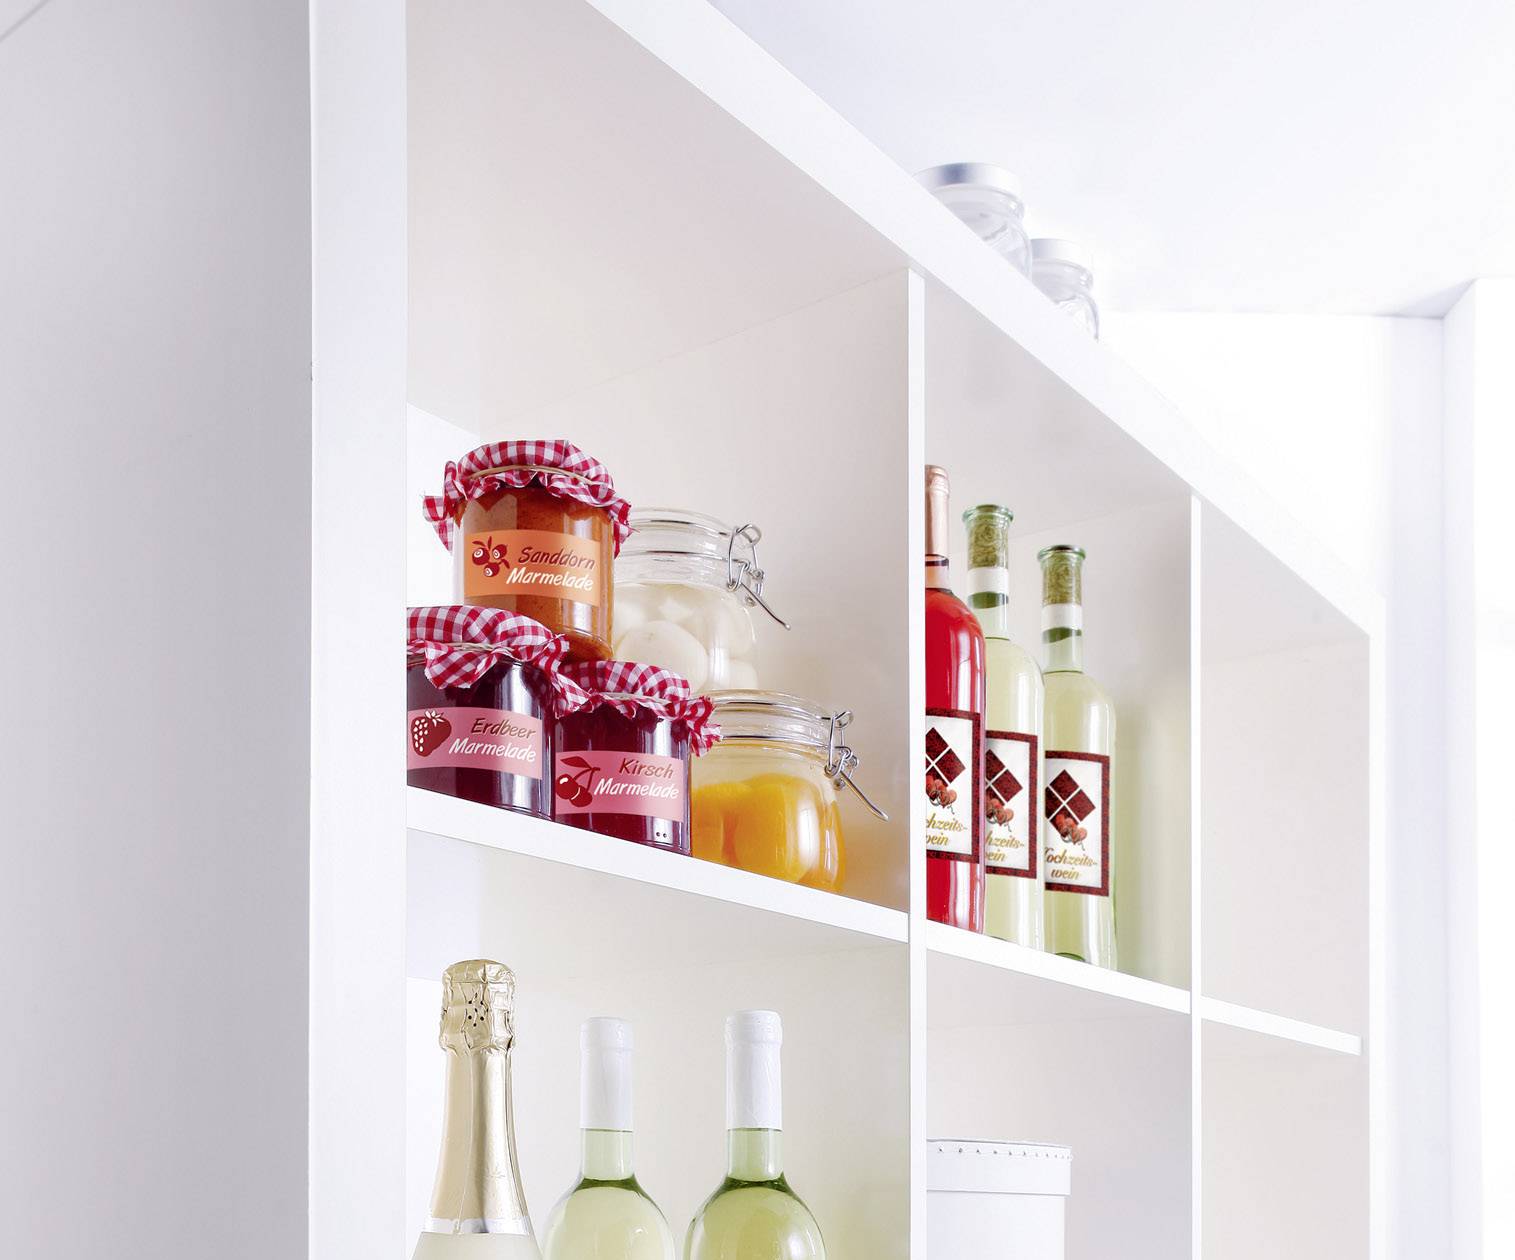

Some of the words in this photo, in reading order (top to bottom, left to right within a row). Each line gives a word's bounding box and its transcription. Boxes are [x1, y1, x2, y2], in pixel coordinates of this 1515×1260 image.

[518, 546, 596, 570] Sanddorn
[506, 567, 593, 591] Marmelade
[471, 717, 536, 739] Erdbeer
[448, 737, 537, 762] Marmelade
[618, 757, 674, 779] Kirsch
[594, 778, 680, 799] Marmelade
[985, 849, 1006, 862] ein
[1050, 867, 1080, 880] wein
